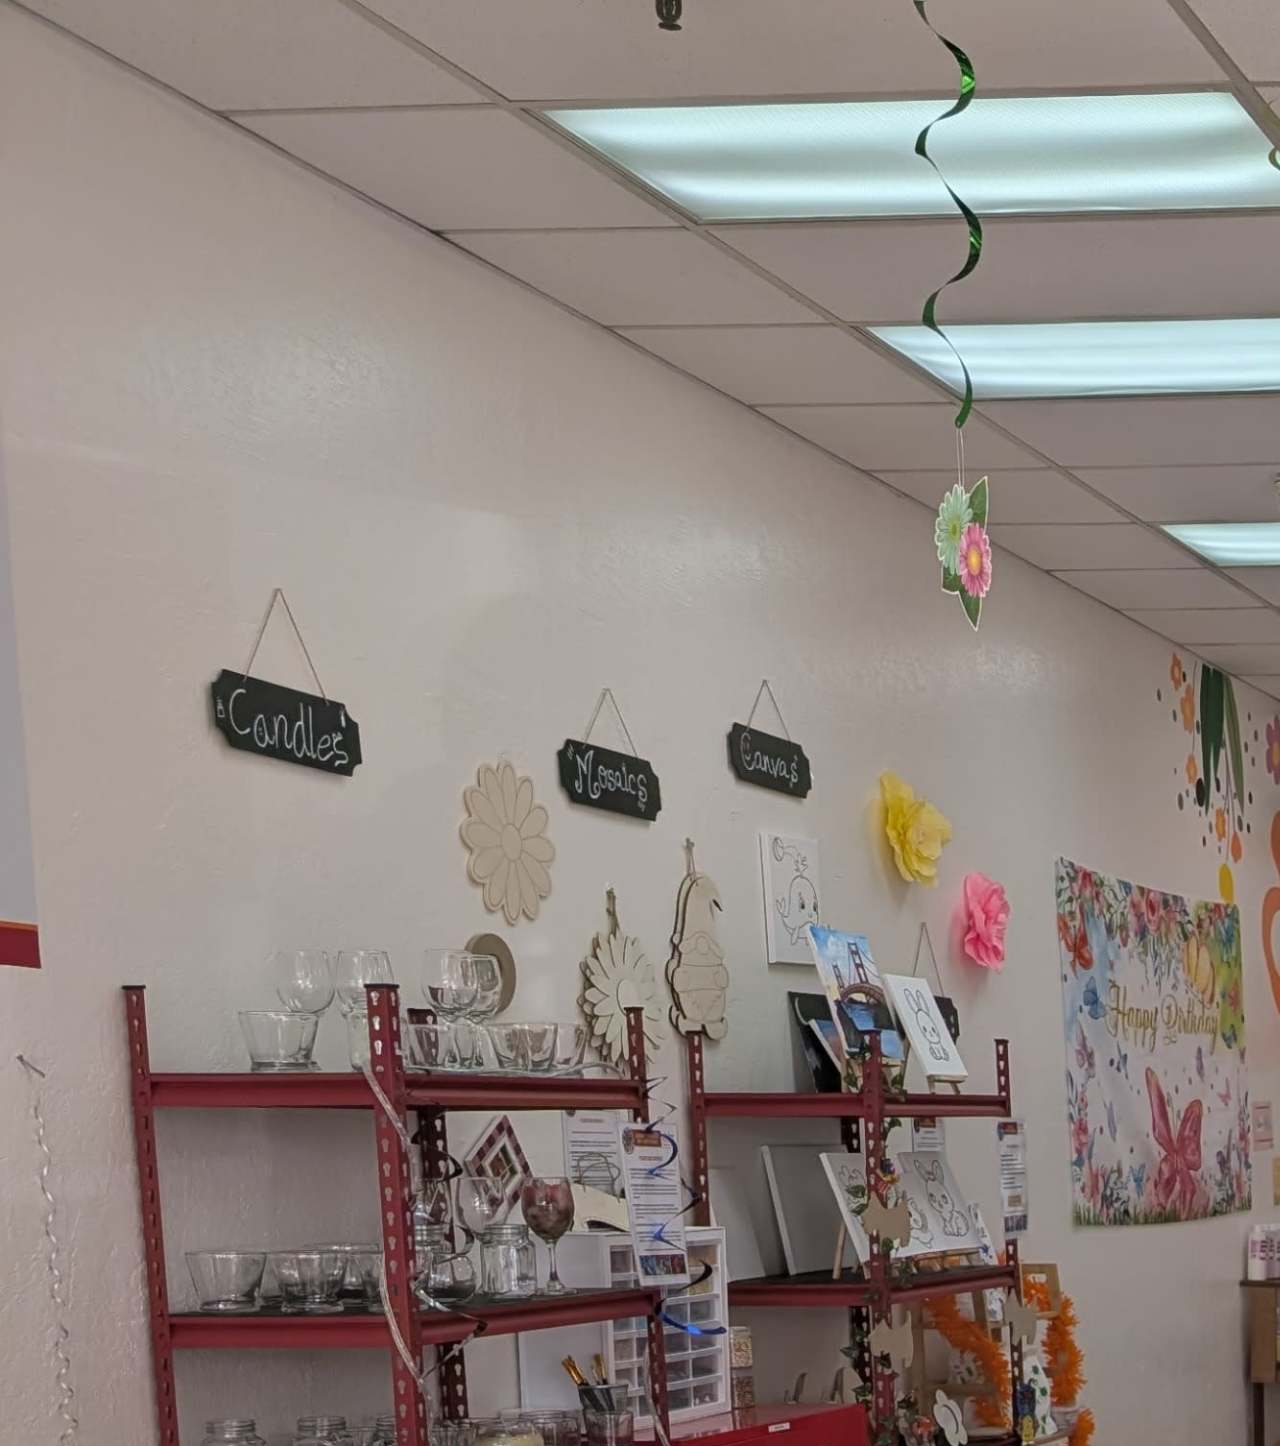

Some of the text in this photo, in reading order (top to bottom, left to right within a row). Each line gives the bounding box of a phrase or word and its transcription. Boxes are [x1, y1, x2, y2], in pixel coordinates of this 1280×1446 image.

[229, 688, 349, 768] Candles
[576, 749, 648, 802] Mosaics
[1105, 979, 1158, 1053] Happy
